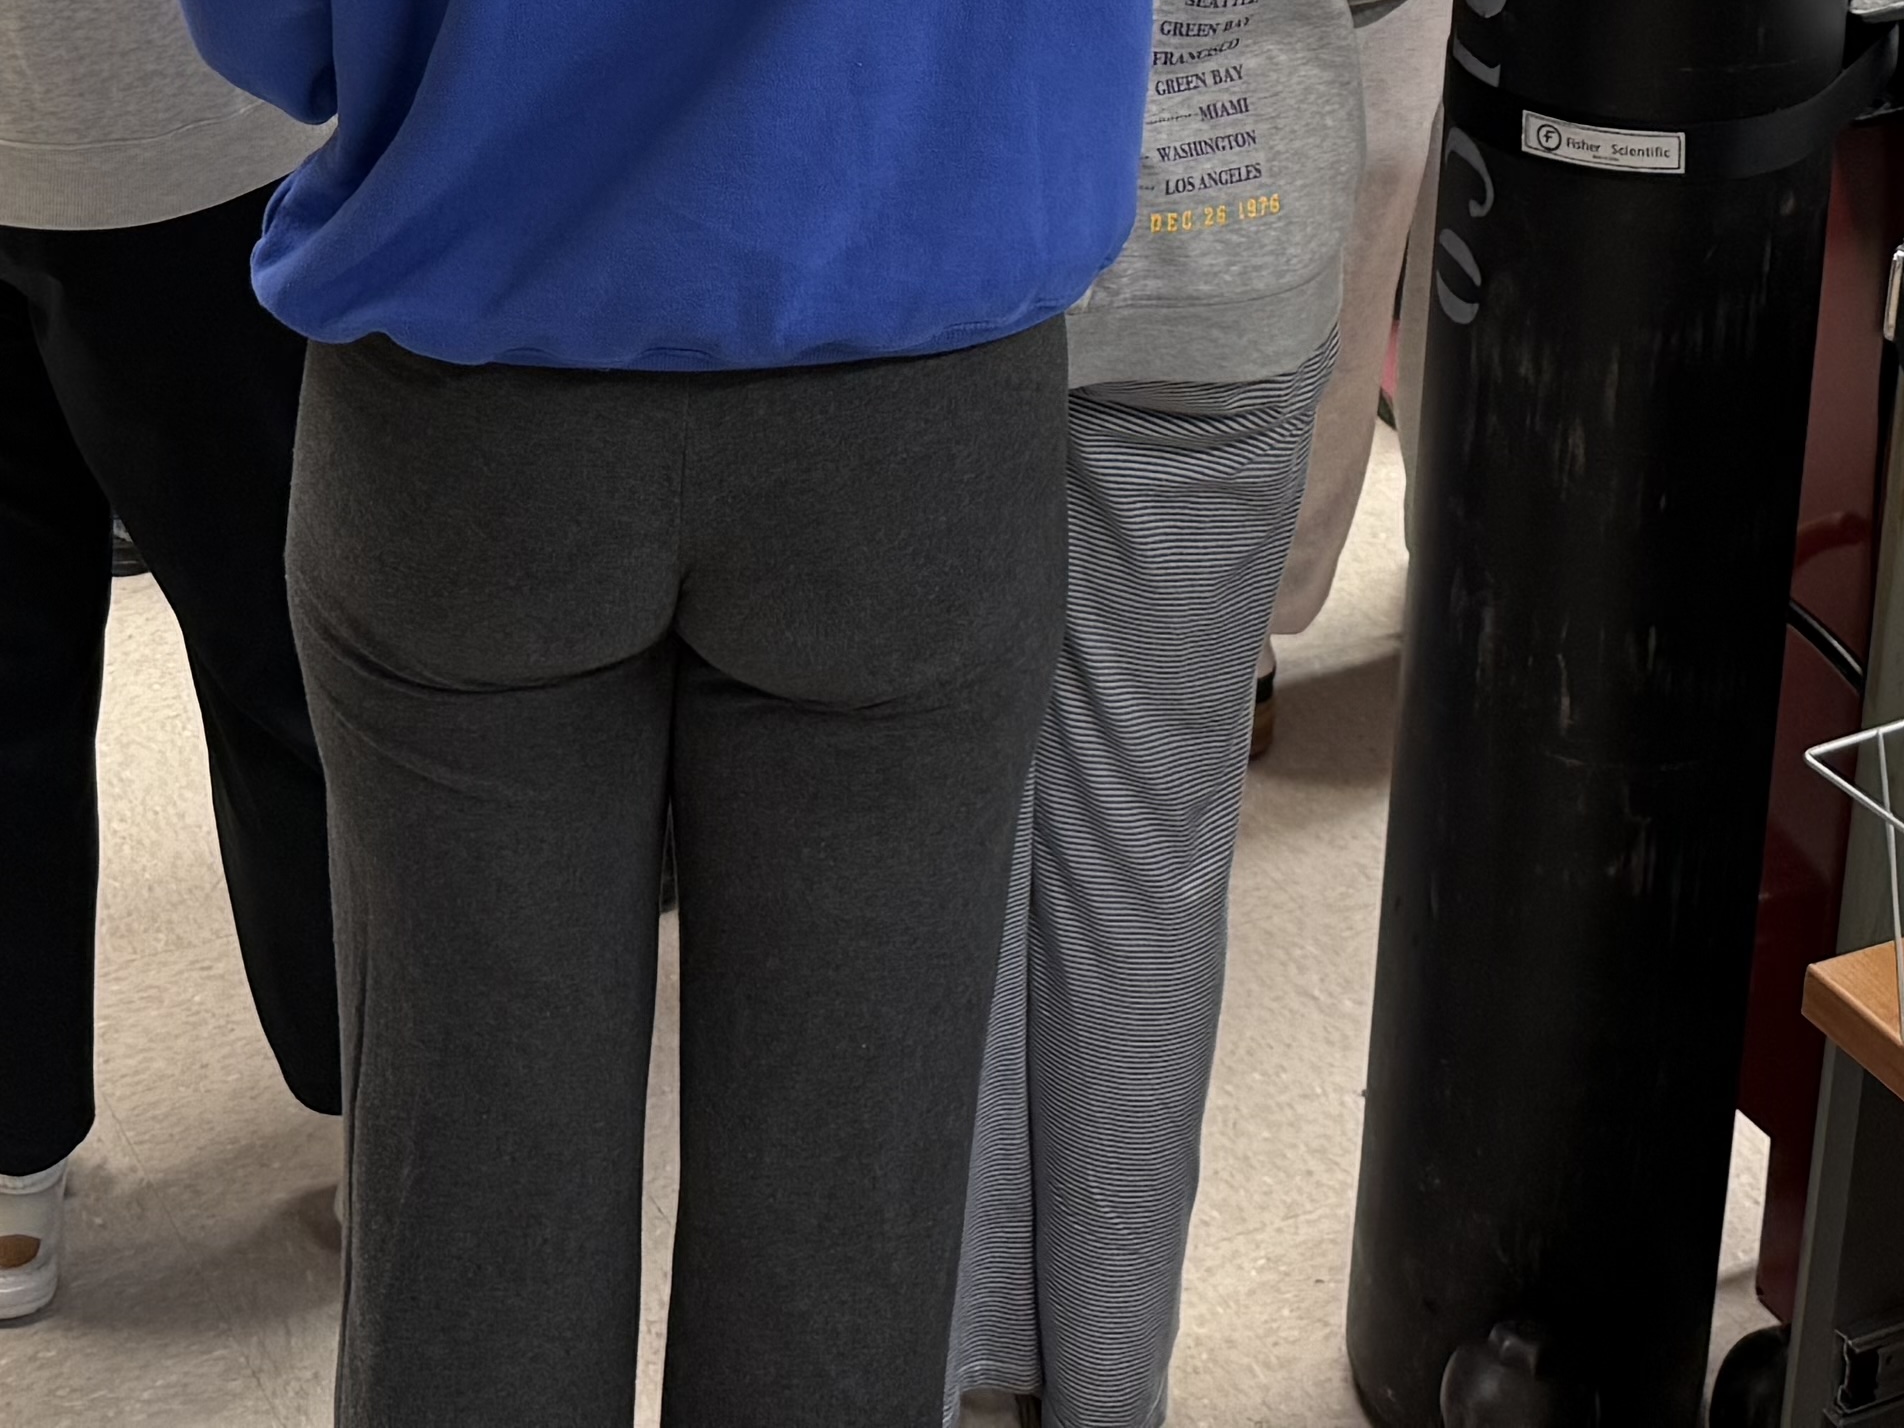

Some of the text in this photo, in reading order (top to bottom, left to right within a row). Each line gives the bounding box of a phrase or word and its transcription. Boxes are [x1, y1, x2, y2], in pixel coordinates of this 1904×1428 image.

[1159, 19, 1219, 38] GREEN
[1154, 63, 1244, 96] GREEN BAY
[1197, 96, 1250, 122] MIAMI
[1156, 129, 1257, 163] WASHINGTON
[1566, 136, 1601, 153] Fisher
[1611, 144, 1671, 159] Scientific
[1164, 162, 1262, 196] LOS ANGELES
[1149, 192, 1281, 233] DEC 26 1976
